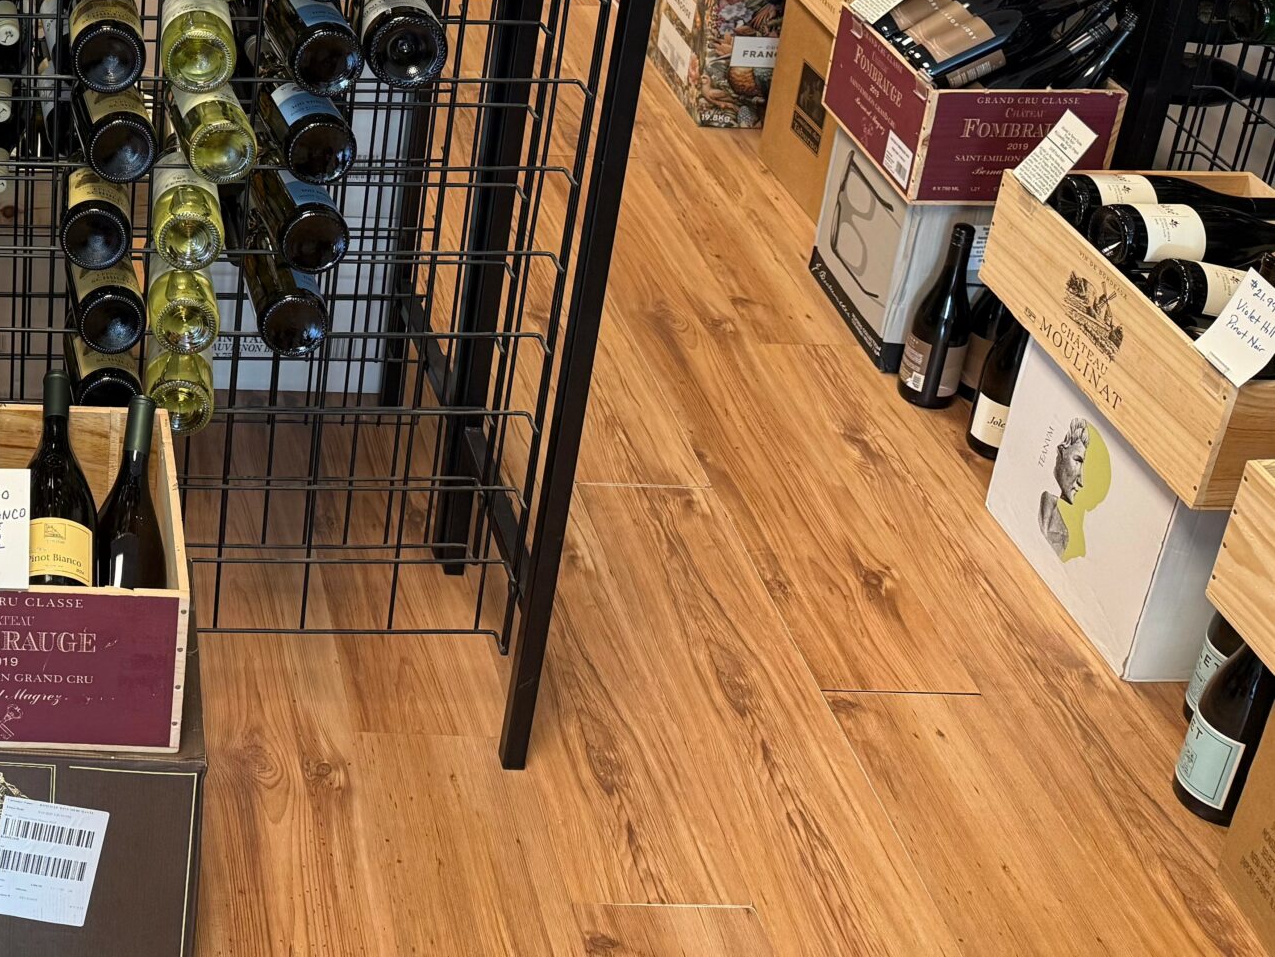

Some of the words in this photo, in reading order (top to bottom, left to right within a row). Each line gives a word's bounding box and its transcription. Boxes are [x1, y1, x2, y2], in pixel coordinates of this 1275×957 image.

[854, 44, 903, 108] FOMBRAUGE
[1042, 97, 1081, 105] CLASSE
[1005, 107, 1046, 118] CHÂTEAU
[1237, 298, 1261, 324] Violet
[1226, 314, 1248, 339] Pinot
[1247, 336, 1265, 352] Noir
[1061, 323, 1108, 375] CHÂTEAU
[1039, 316, 1122, 410] MOULINAT
[53, 554, 81, 567] Bianco
[25, 597, 84, 609] CLASSE
[14, 673, 63, 684] GRAND
[66, 674, 94, 684] CRU
[4, 687, 60, 705] Magrez
